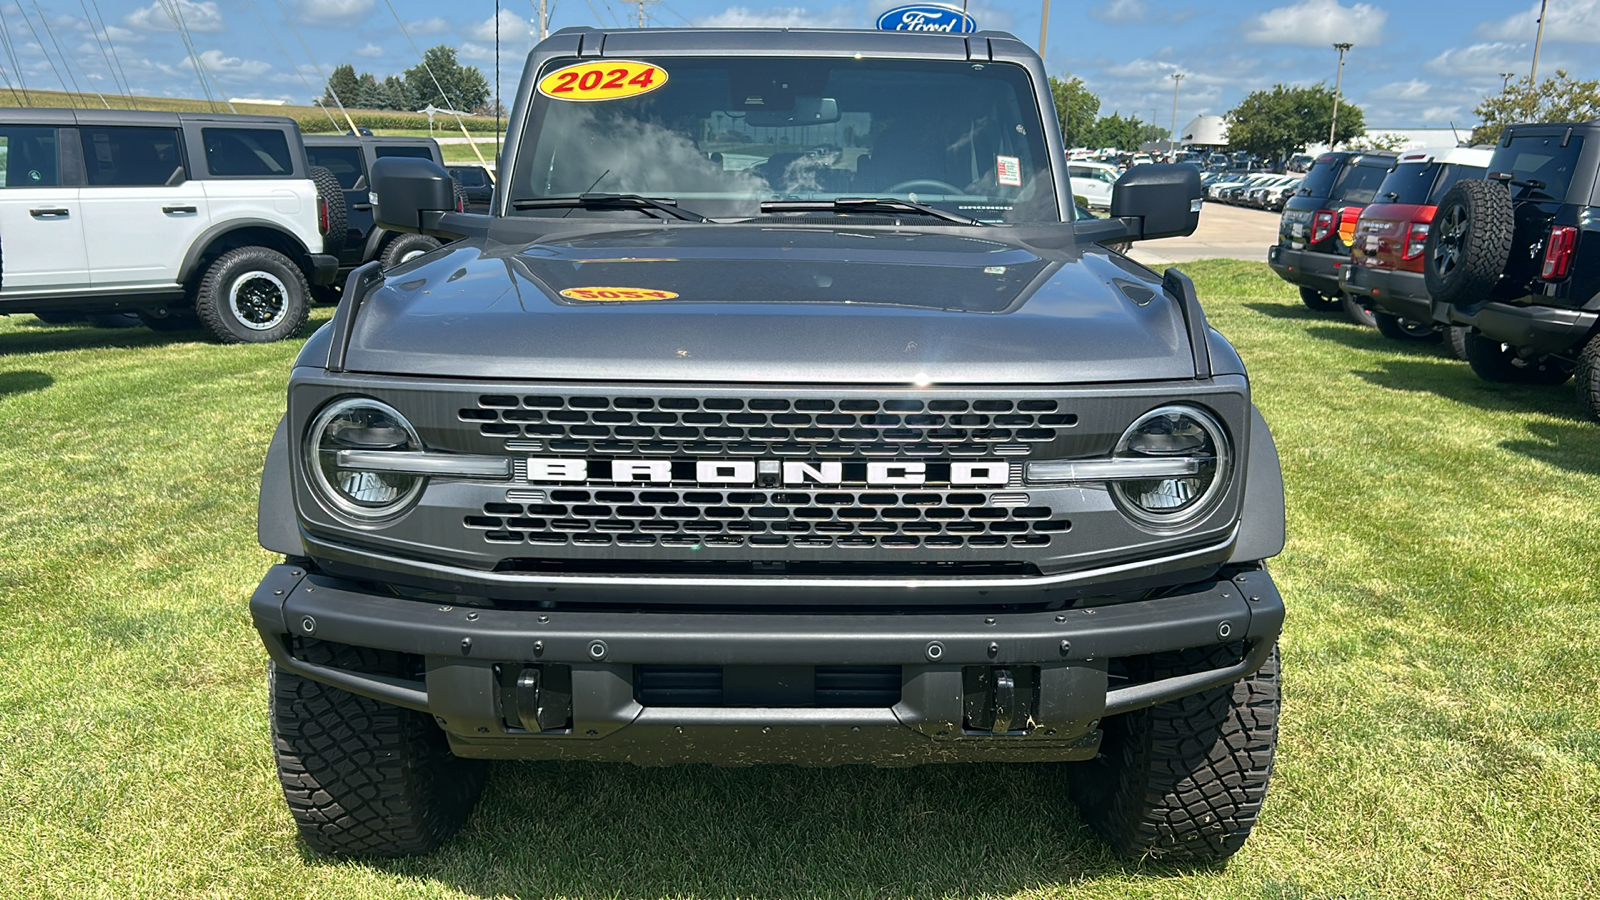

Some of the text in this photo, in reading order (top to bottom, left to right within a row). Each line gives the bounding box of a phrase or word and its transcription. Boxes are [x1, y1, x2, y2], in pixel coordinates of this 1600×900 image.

[896, 11, 957, 33] Ford
[551, 68, 654, 93] 2024
[527, 459, 1010, 483] BRONCO
